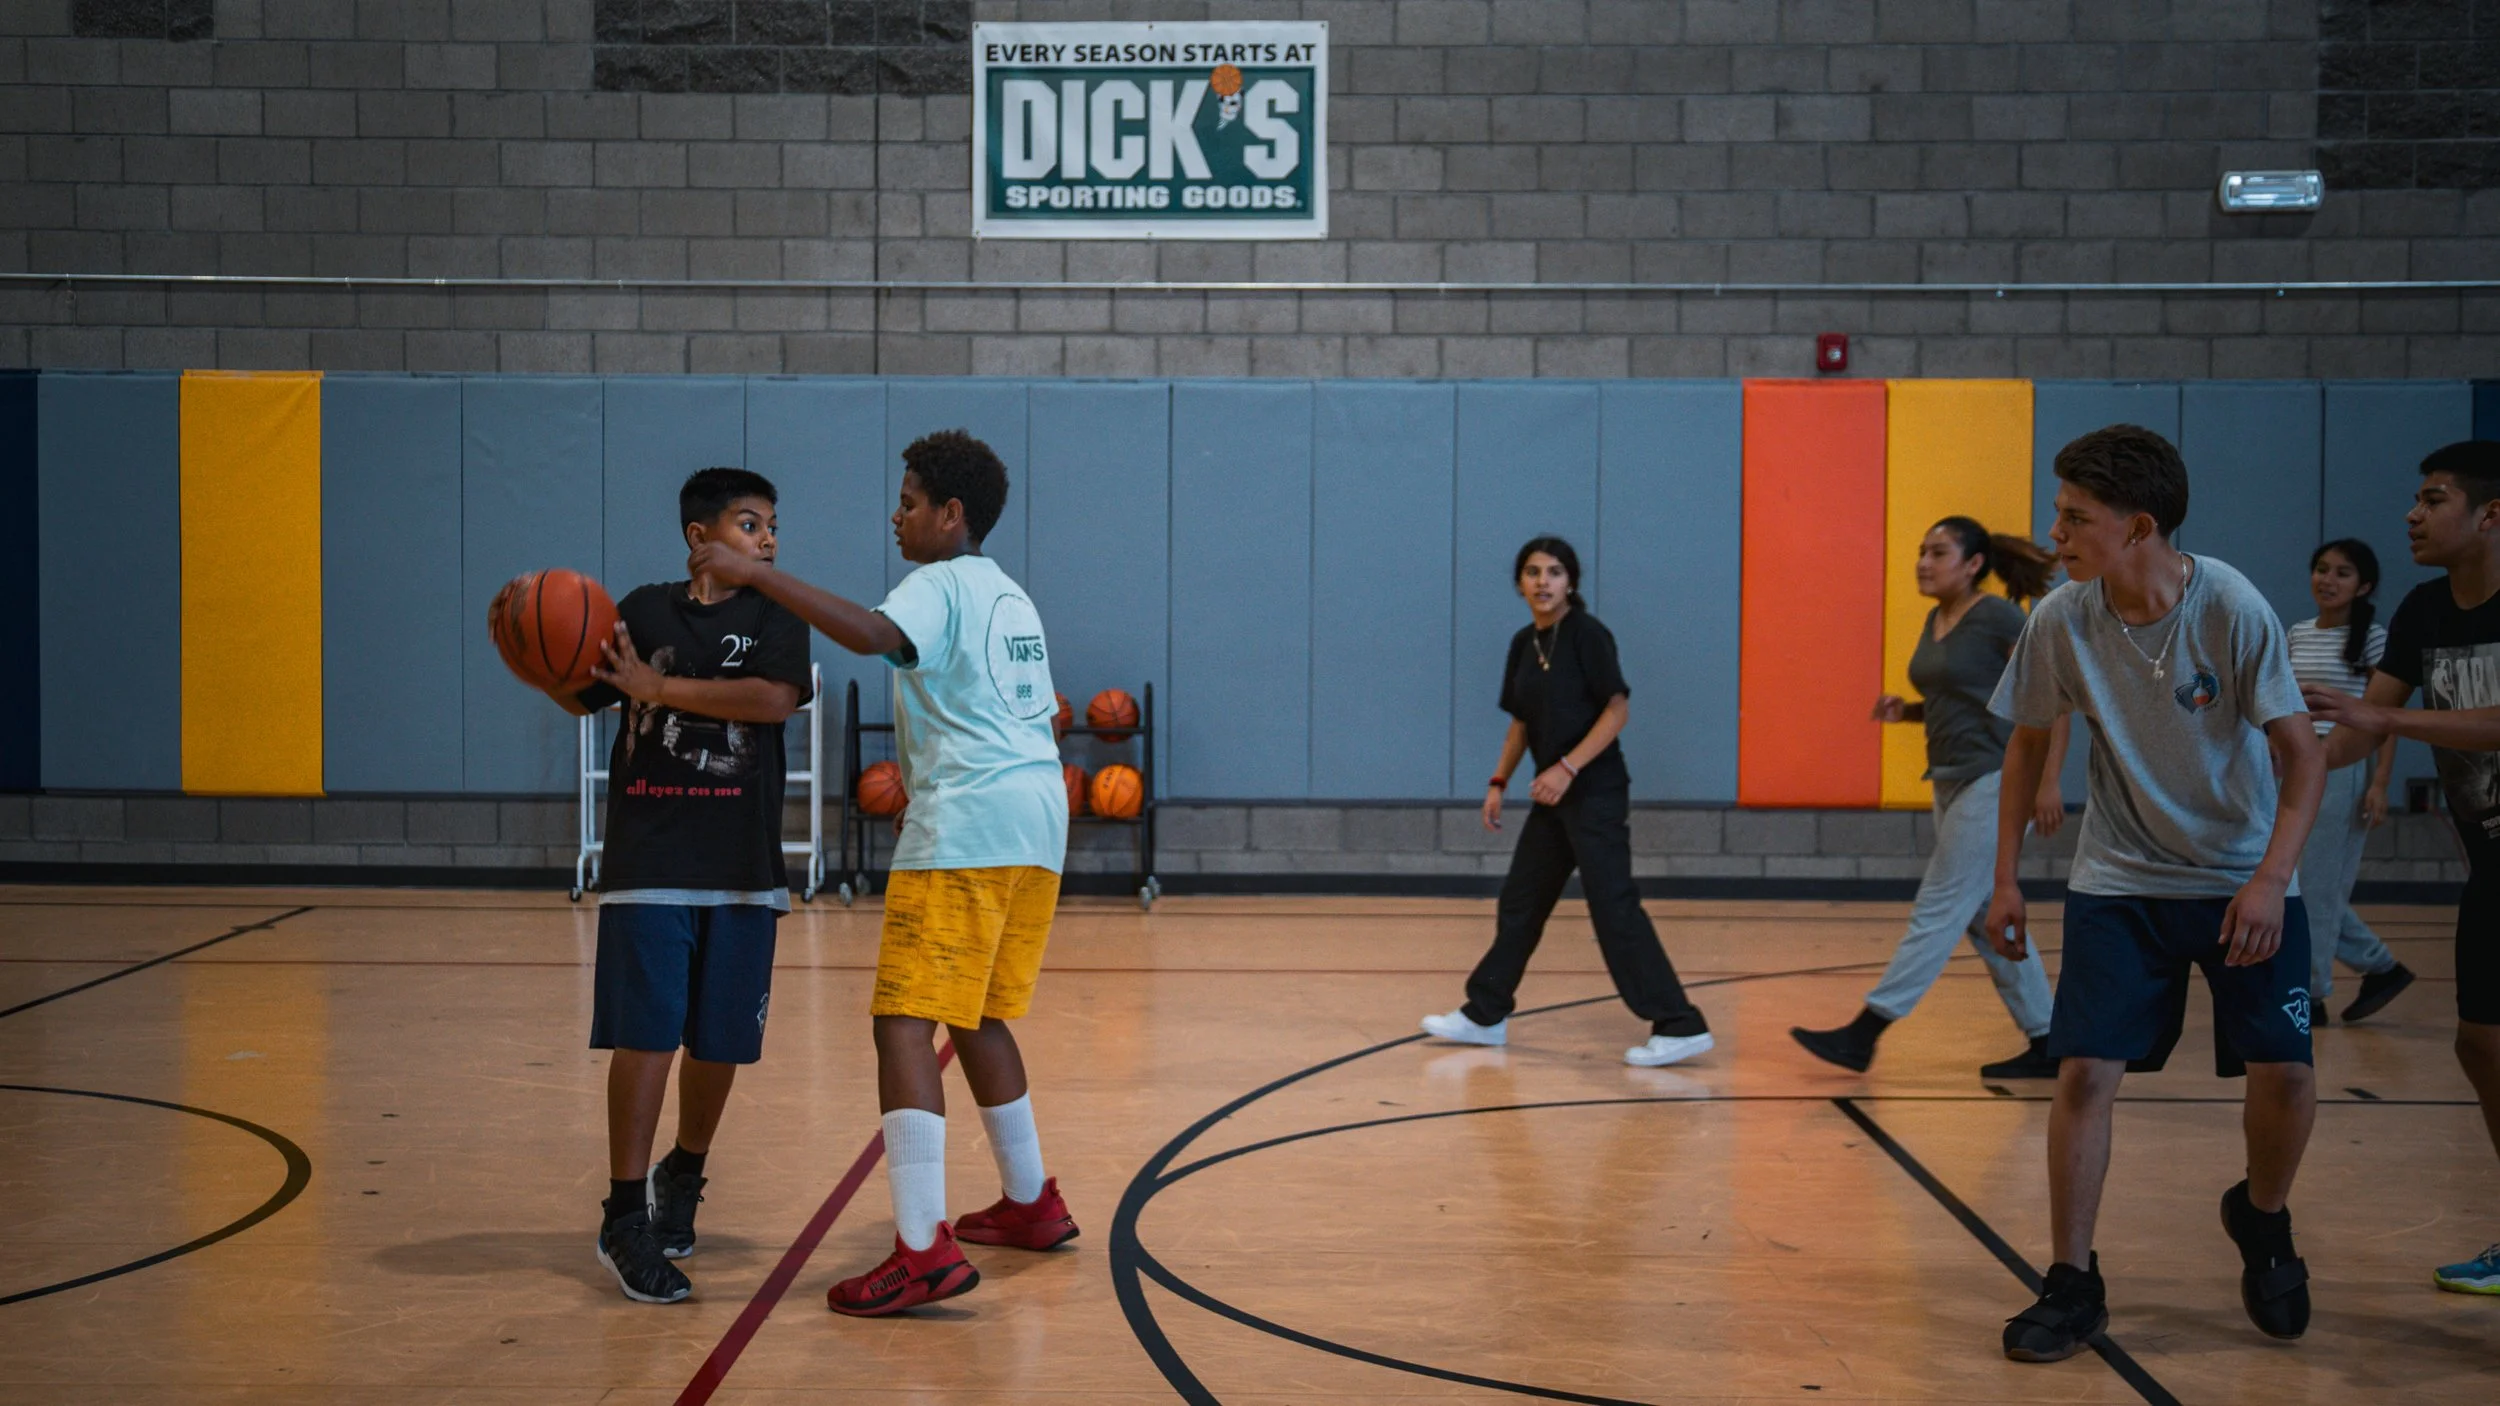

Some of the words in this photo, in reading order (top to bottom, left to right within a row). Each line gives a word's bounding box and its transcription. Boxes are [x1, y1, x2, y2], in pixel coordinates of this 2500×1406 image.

[986, 44, 1067, 62] EVERY
[1073, 43, 1176, 62] SEASON
[1183, 43, 1277, 62] STARTS
[1284, 43, 1316, 62] AT
[1005, 185, 1170, 209] SPORTING
[1004, 635, 1044, 662] VANS
[626, 779, 647, 795] all
[687, 787, 710, 796] on
[714, 787, 742, 796] me
